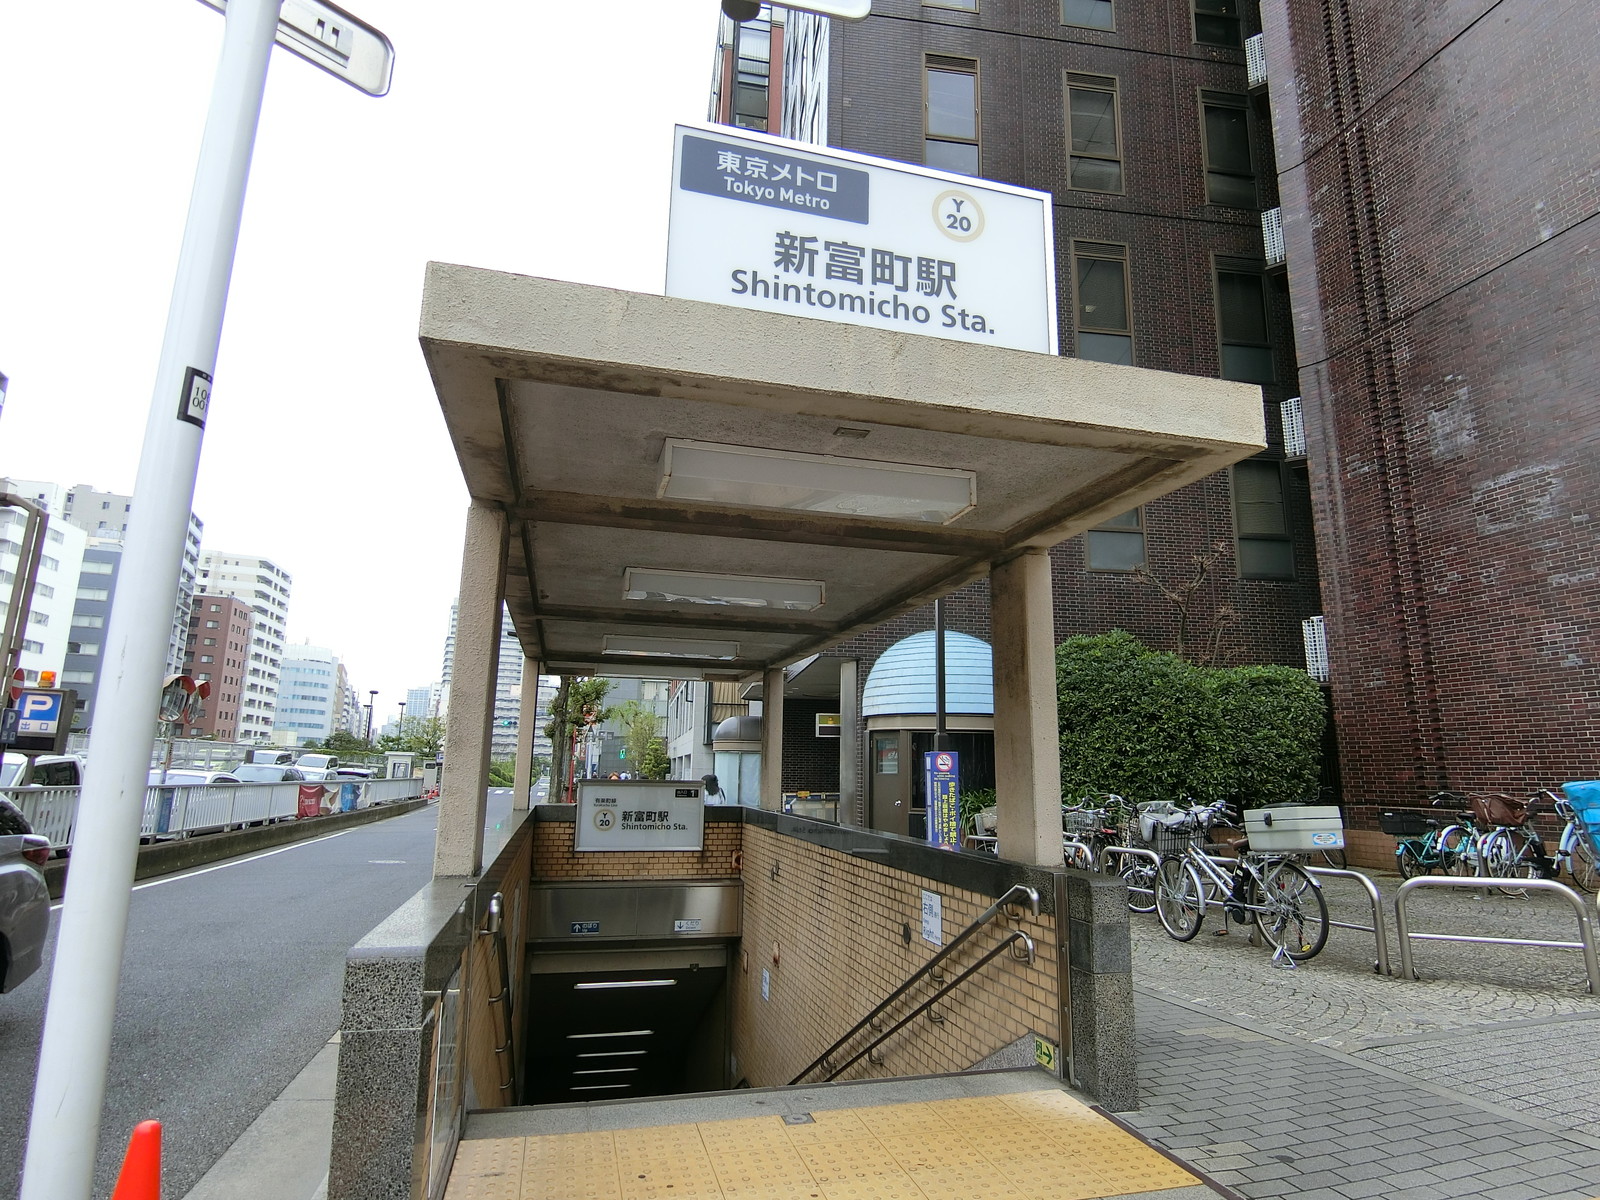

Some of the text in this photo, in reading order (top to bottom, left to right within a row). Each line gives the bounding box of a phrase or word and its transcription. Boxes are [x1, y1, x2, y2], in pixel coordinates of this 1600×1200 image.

[716, 150, 838, 193] 東京メトロ
[723, 176, 830, 210] Tokyo Metro
[951, 198, 965, 213] Y
[946, 213, 972, 232] 20
[773, 230, 957, 300] 新富町駅
[731, 269, 995, 335] Shintomicho Sta.
[23, 695, 53, 718] P
[6, 712, 16, 729] P
[599, 819, 610, 827] 20
[621, 810, 669, 822] 新富町駅
